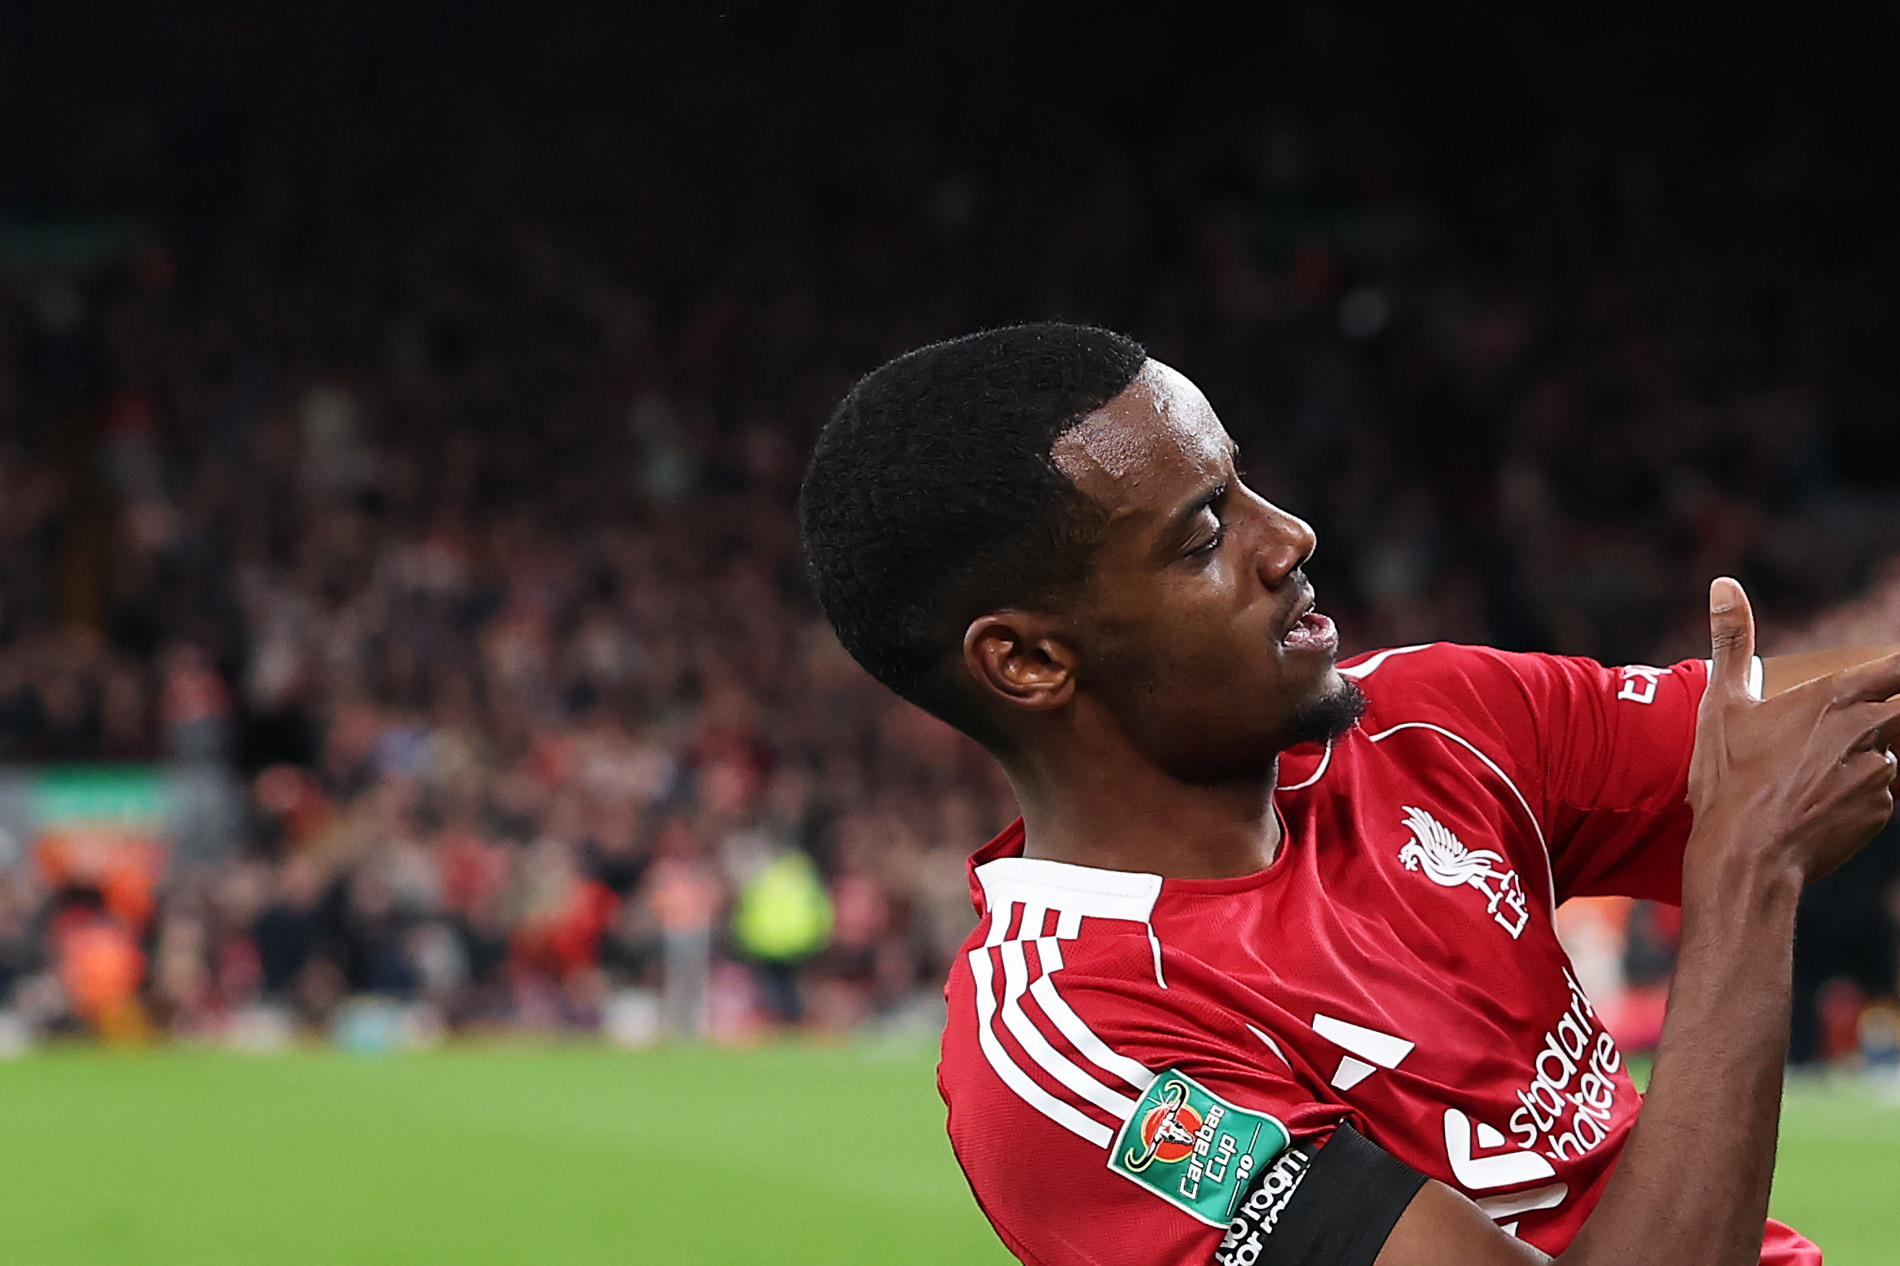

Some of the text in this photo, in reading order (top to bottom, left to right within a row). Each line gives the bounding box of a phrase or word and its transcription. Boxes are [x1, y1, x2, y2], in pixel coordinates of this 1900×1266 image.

[1509, 966, 1594, 1149] stadar
[1179, 1105, 1226, 1199] Carabao
[1205, 1132, 1238, 1183] Cup
[1236, 1154, 1254, 1179] 10
[1240, 1150, 1309, 1220] room
